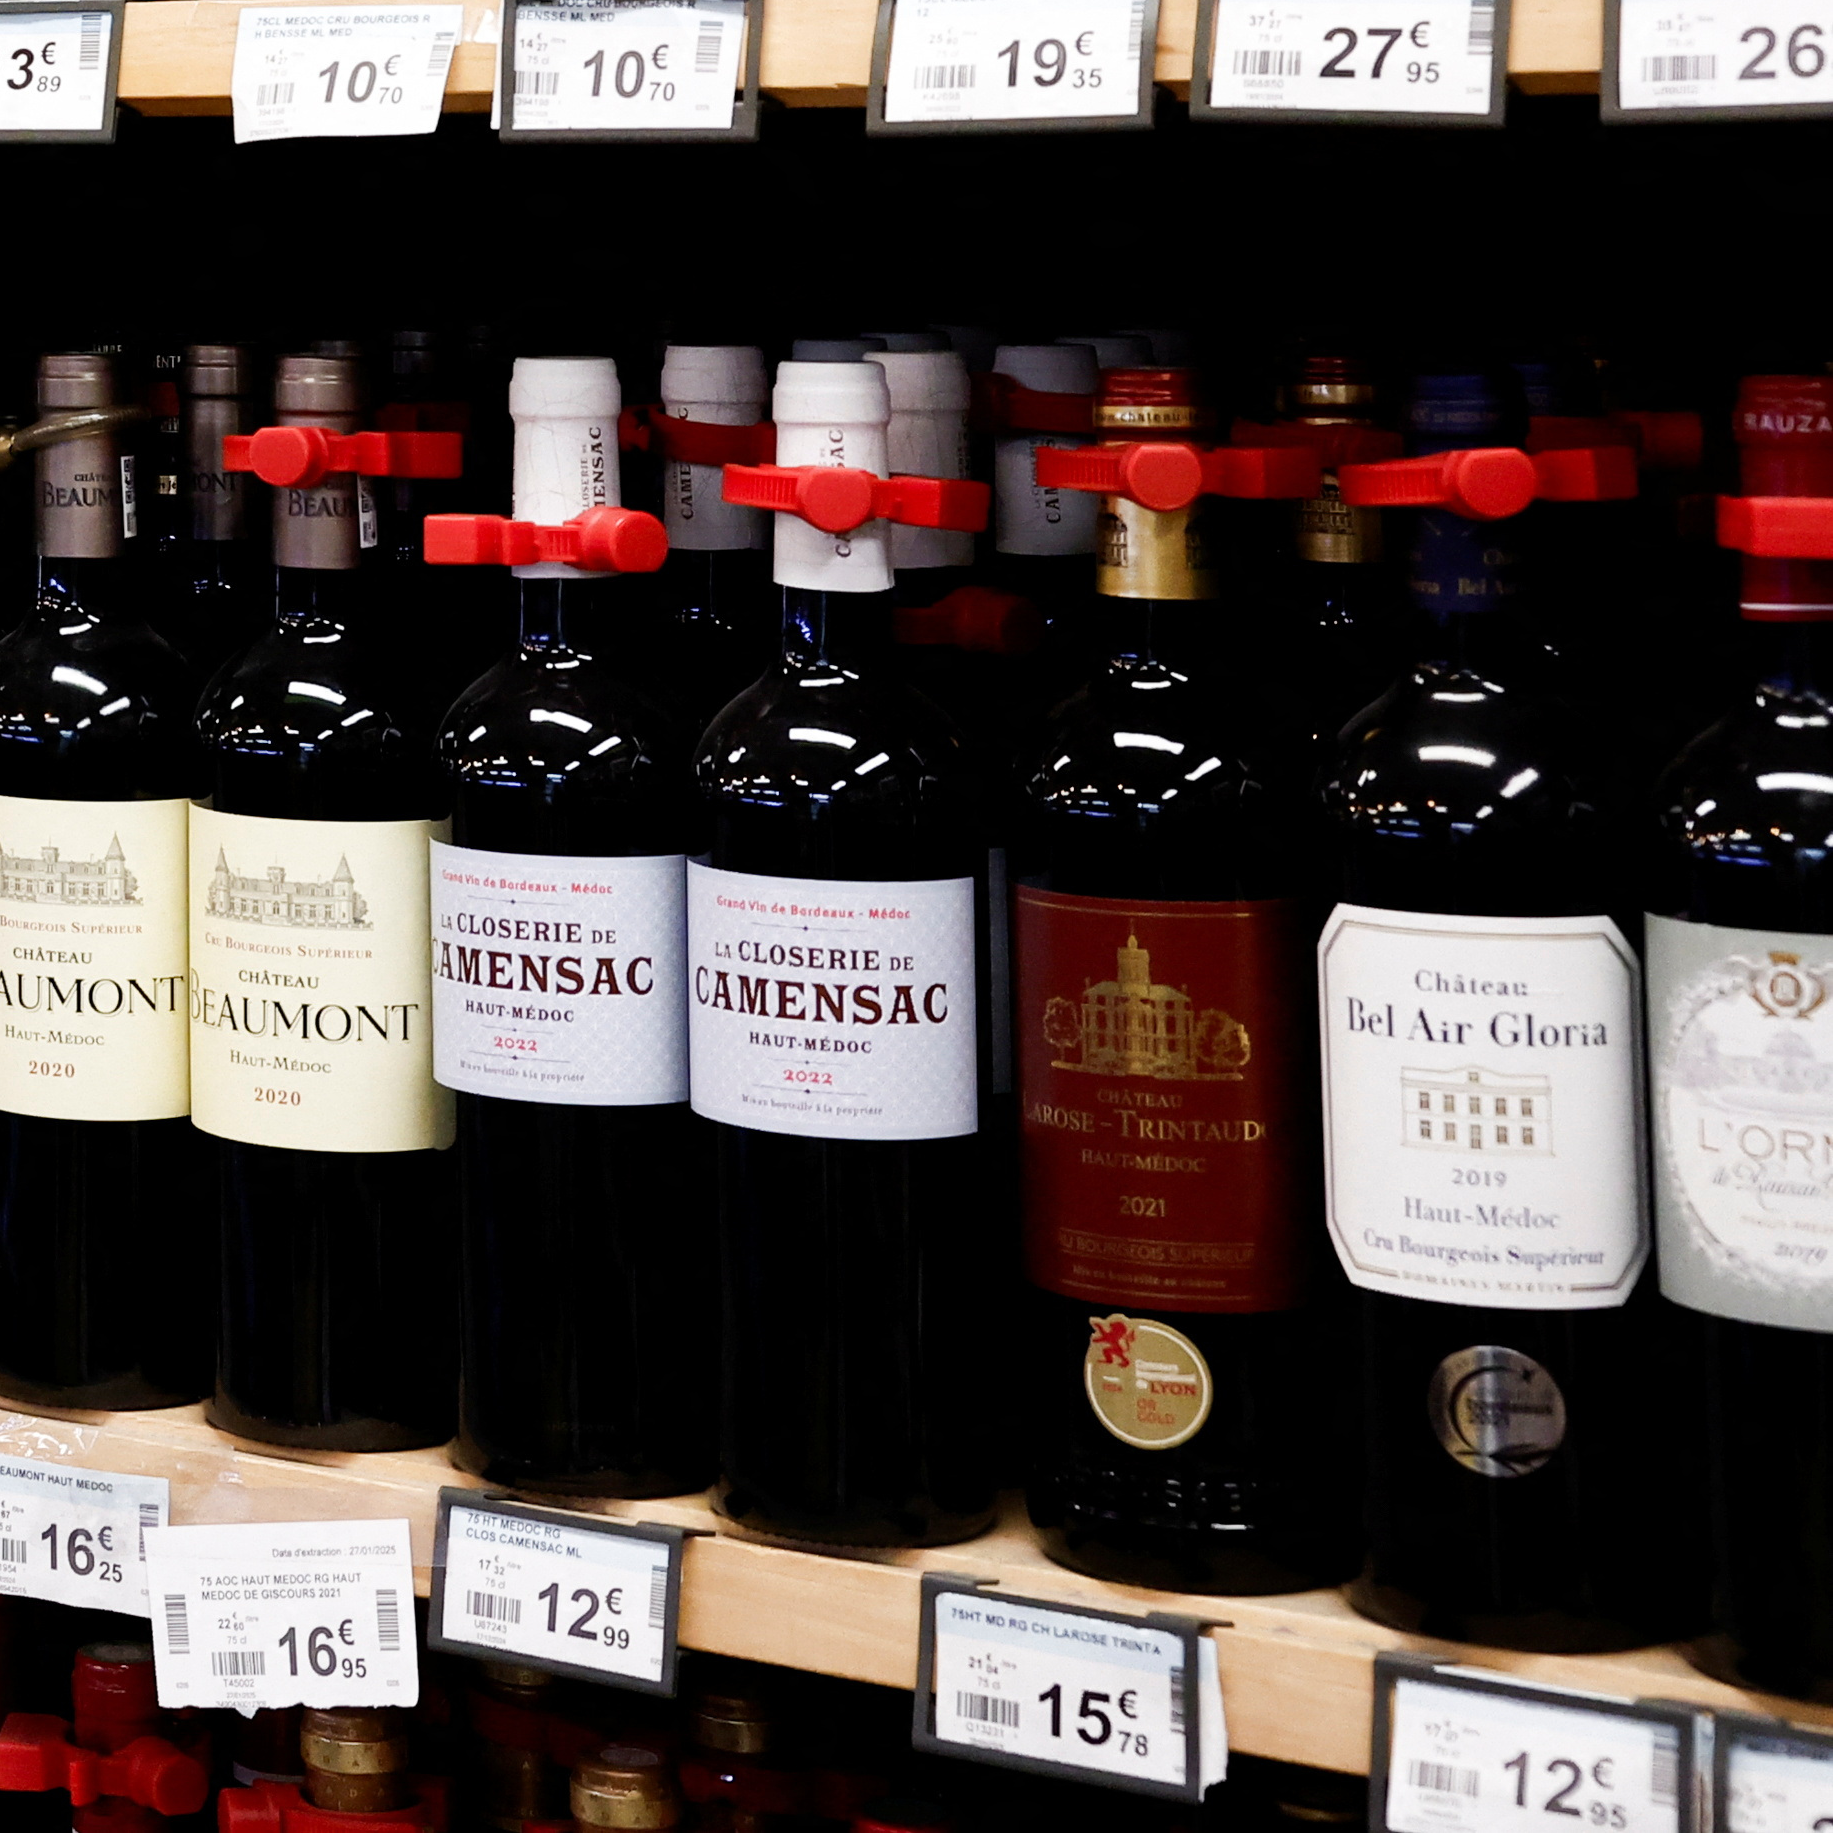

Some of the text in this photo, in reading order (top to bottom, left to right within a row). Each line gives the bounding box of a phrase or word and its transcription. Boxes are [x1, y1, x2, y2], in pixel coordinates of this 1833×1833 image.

[287, 15, 420, 25] MEDOC CRU BOURGEOIS
[265, 30, 304, 38] BENSSE
[329, 28, 353, 36] MED
[717, 895, 910, 918] Grand Vin de Bordeaux Médoc
[0, 917, 66, 934] BOURGEOIS
[71, 920, 143, 935] SUPÉRIEUR
[441, 912, 616, 944] LA CLOSERIE DE
[13, 945, 92, 964] CHÂTEAU
[696, 965, 949, 1024] CAMENSAC
[1347, 998, 1608, 1048] Bel Air Gloria
[29, 1060, 75, 1078] 2020
[783, 1069, 833, 1085] 2022
[255, 1087, 302, 1106] 2020
[1150, 1382, 1196, 1396] LYON
[201, 1572, 361, 1586] 75 AOC HAUT MEDOC RG HAUT
[201, 1588, 341, 1600] MEDOC DE GISCOURS 2021
